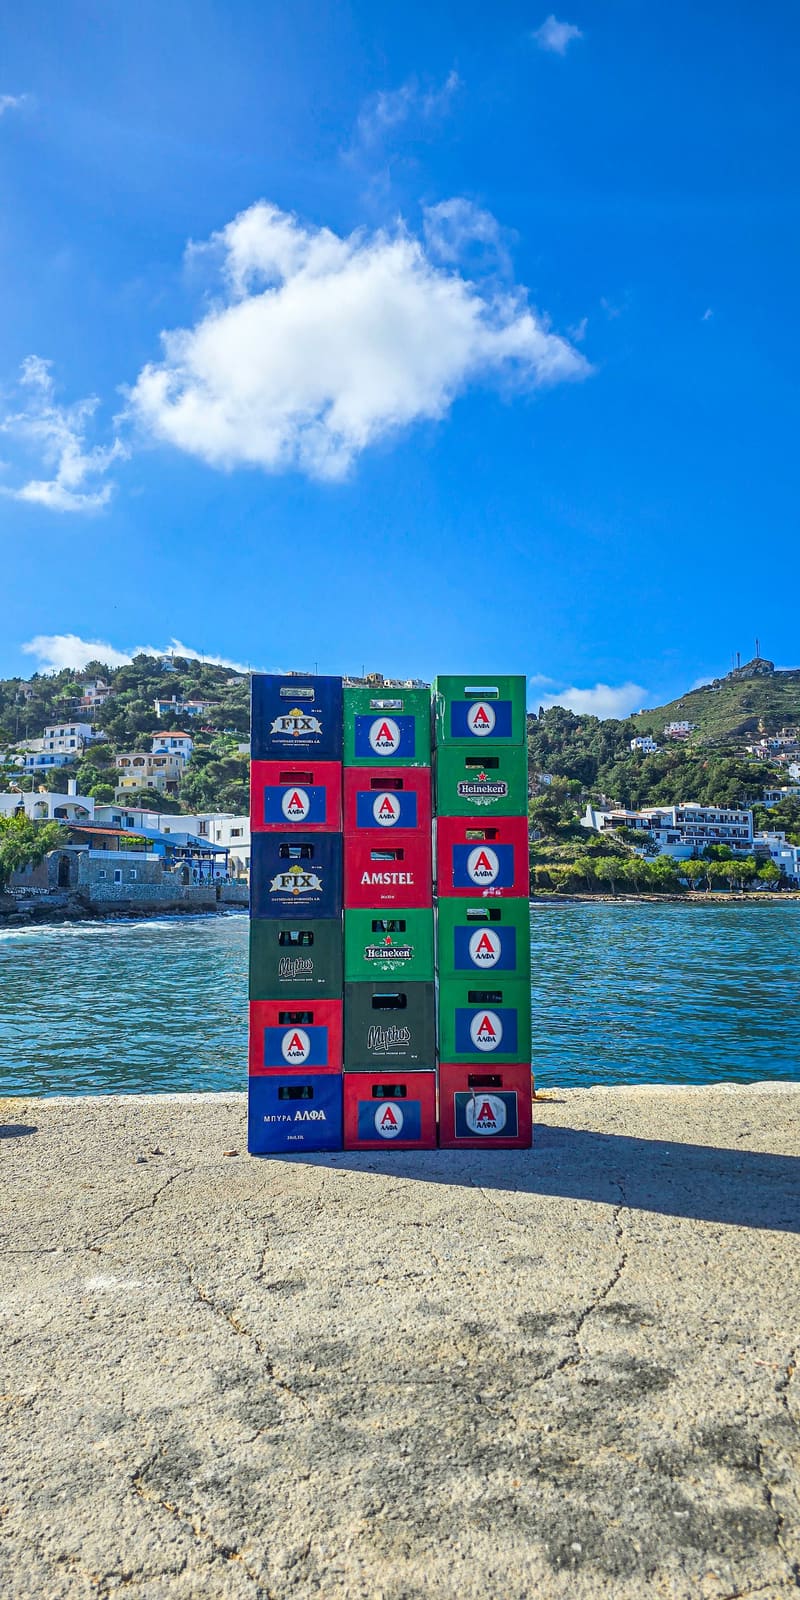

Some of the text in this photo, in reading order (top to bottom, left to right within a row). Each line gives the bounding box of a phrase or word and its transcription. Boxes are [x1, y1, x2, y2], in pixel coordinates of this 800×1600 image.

[280, 718, 314, 730] FIX
[461, 784, 504, 793] Heineken
[280, 875, 314, 887] FIX
[360, 871, 414, 885] AMSTEL
[367, 949, 410, 958] Heineken
[278, 956, 314, 978] Mythos
[367, 1025, 411, 1050] Mythos
[294, 1110, 327, 1121] ΑΛΦΑ
